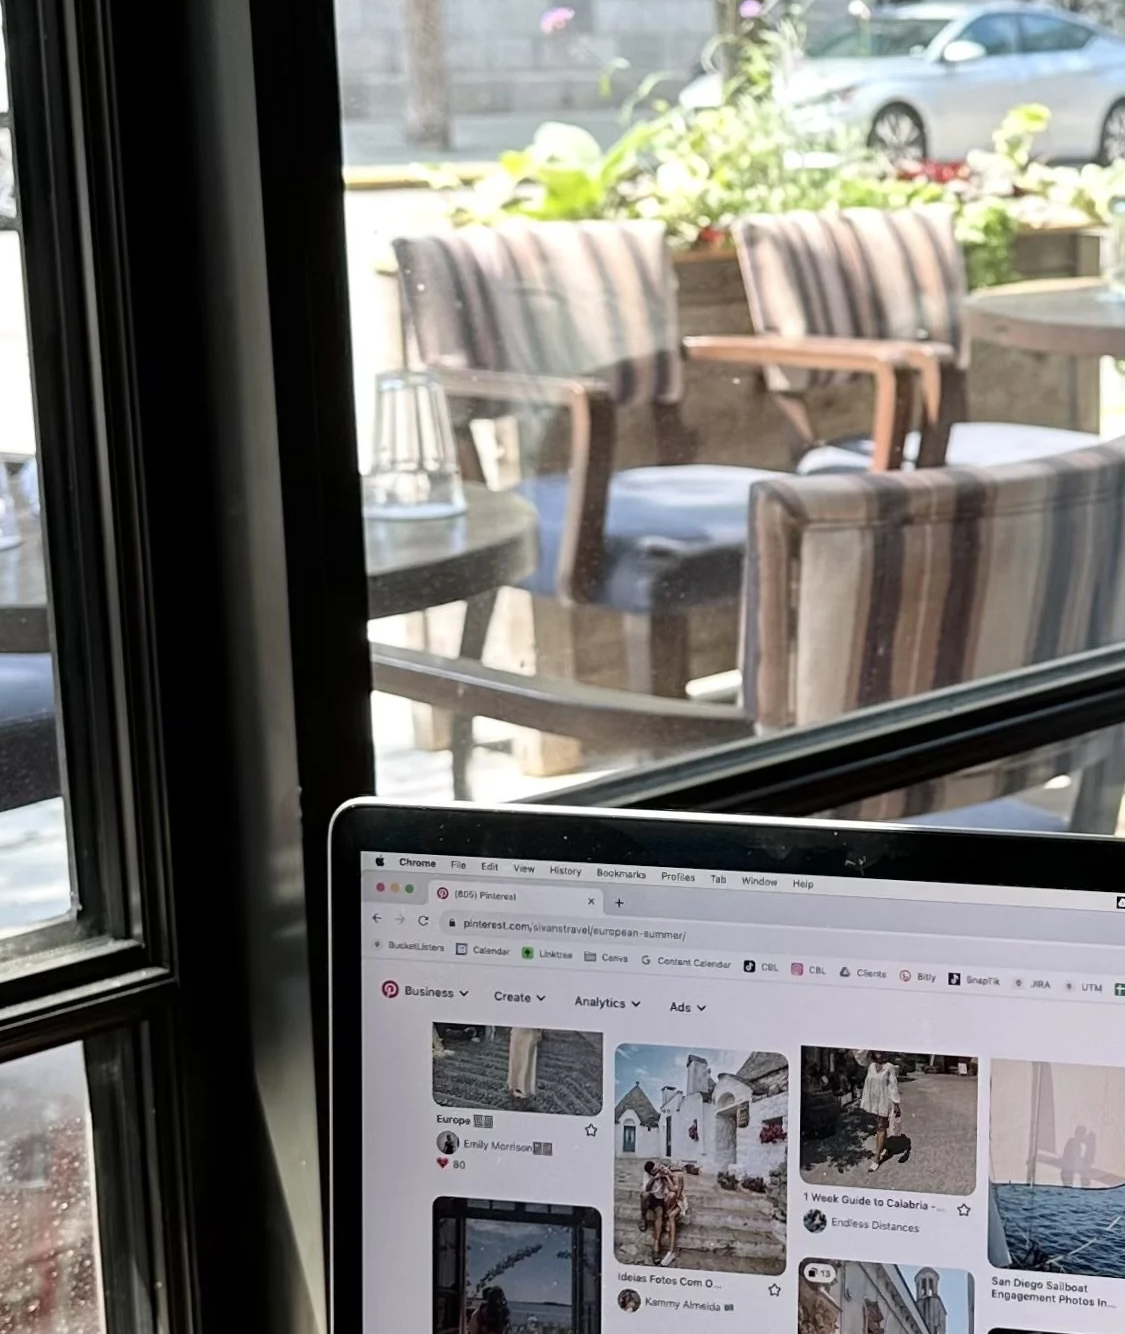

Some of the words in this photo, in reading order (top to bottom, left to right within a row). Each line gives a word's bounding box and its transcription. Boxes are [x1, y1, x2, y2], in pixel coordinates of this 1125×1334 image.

[400, 858, 436, 868] Chrome
[451, 861, 466, 870] File
[481, 862, 498, 871] Edit
[514, 864, 535, 873] View
[550, 867, 582, 877] History
[597, 869, 647, 880] Bookmarks
[661, 872, 695, 882] Profiles
[711, 874, 726, 884] Tab
[742, 876, 778, 887] Window
[793, 879, 814, 890] Help
[480, 891, 517, 902] Pinterest
[473, 946, 510, 955] Calendar
[539, 950, 573, 960] Linktree
[658, 956, 692, 967] Content
[694, 958, 731, 969] Calendar
[761, 962, 779, 972] CBL
[809, 965, 826, 975] CBL
[918, 973, 936, 983] Bitly
[1030, 979, 1050, 989] JIRA
[1081, 982, 1103, 993] UTM
[404, 985, 454, 998] Business
[494, 991, 531, 1003] Create
[575, 996, 626, 1009] Analytics
[670, 1002, 691, 1013] Ads
[437, 1115, 470, 1125] Europe
[464, 1140, 488, 1150] Emily
[491, 1141, 533, 1152] Morrison
[453, 1160, 466, 1169] 80
[804, 1193, 808, 1201] 1
[812, 1193, 839, 1205] Week
[841, 1195, 871, 1206] Guide
[873, 1197, 884, 1207] to
[887, 1198, 928, 1210] Calabria
[831, 1218, 869, 1229] Endless
[872, 1220, 920, 1233] Distances
[650, 1275, 677, 1285] Fotos
[680, 1277, 702, 1287] Com
[991, 1277, 1011, 1287] San
[1013, 1278, 1043, 1290] Diego
[1046, 1281, 1088, 1293] Sailboat
[991, 1290, 1056, 1305] Engagement
[1058, 1294, 1095, 1306] Photos
[683, 1301, 721, 1311] Almeida
